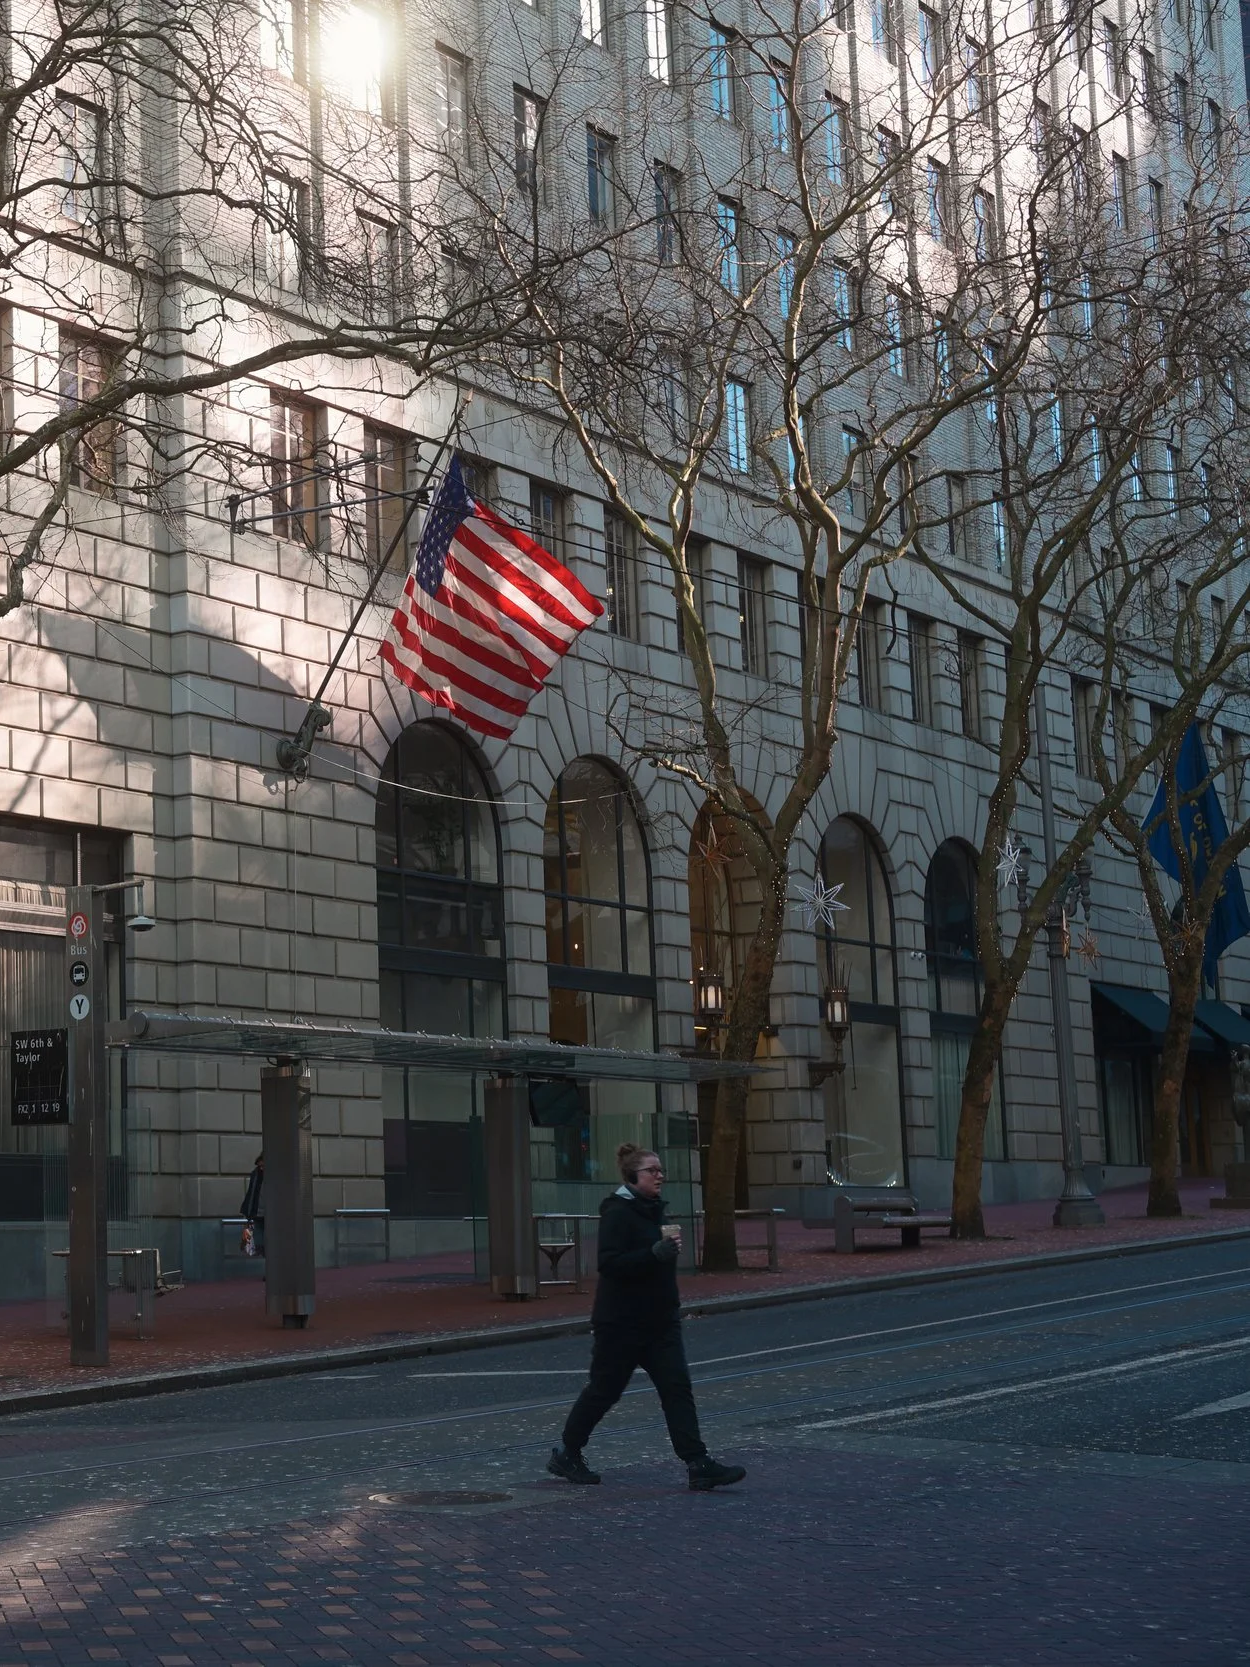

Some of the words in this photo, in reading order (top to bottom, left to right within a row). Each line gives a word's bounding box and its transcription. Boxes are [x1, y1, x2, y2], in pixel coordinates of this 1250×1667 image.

[70, 944, 87, 955] Bus
[75, 998, 84, 1014] Y
[15, 1039, 29, 1050] SW
[30, 1038, 45, 1048] 6th
[46, 1037, 53, 1048] &
[15, 1052, 40, 1065] Taylor
[32, 1103, 36, 1113] 1
[41, 1103, 49, 1113] 12
[52, 1102, 60, 1113] 19
